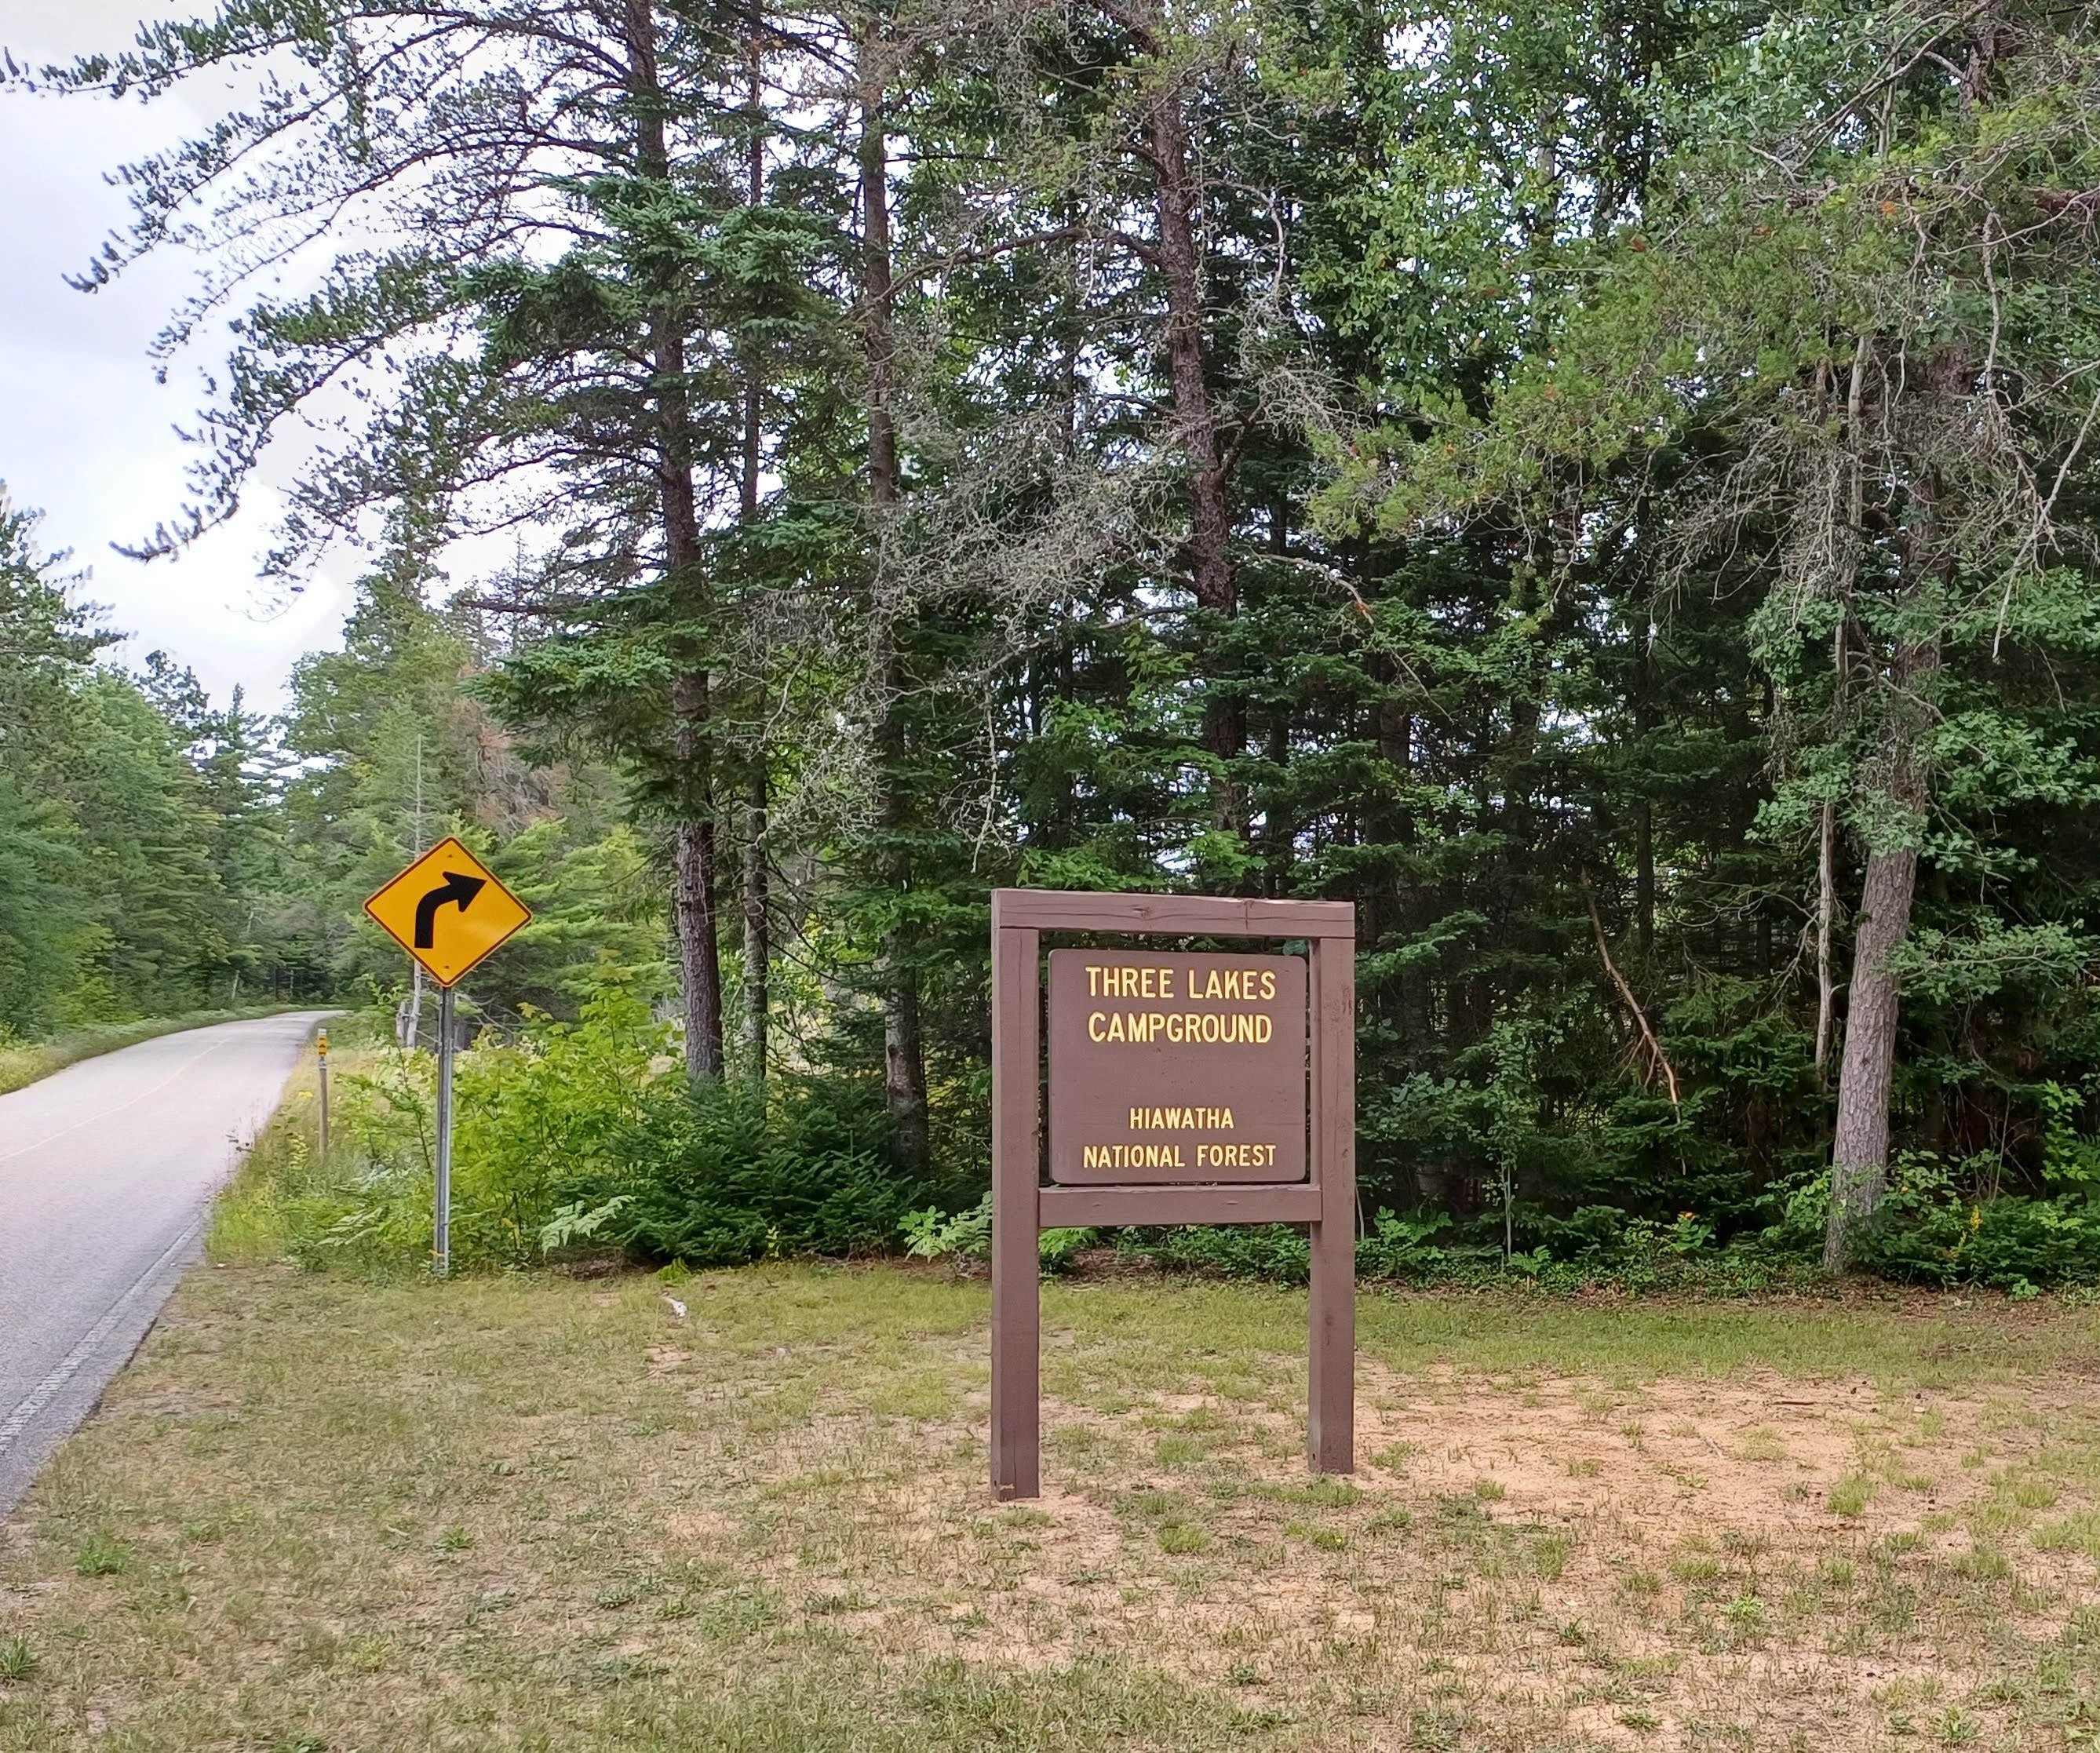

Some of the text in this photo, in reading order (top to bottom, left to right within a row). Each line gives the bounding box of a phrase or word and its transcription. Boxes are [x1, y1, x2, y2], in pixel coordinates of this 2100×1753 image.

[1085, 967, 1276, 1000] THREE LAKES
[1088, 1011, 1272, 1044] CAMPGROUND
[1130, 1107, 1234, 1130] HIAWATHA
[1083, 1144, 1277, 1168] NATIONAL FOREST
